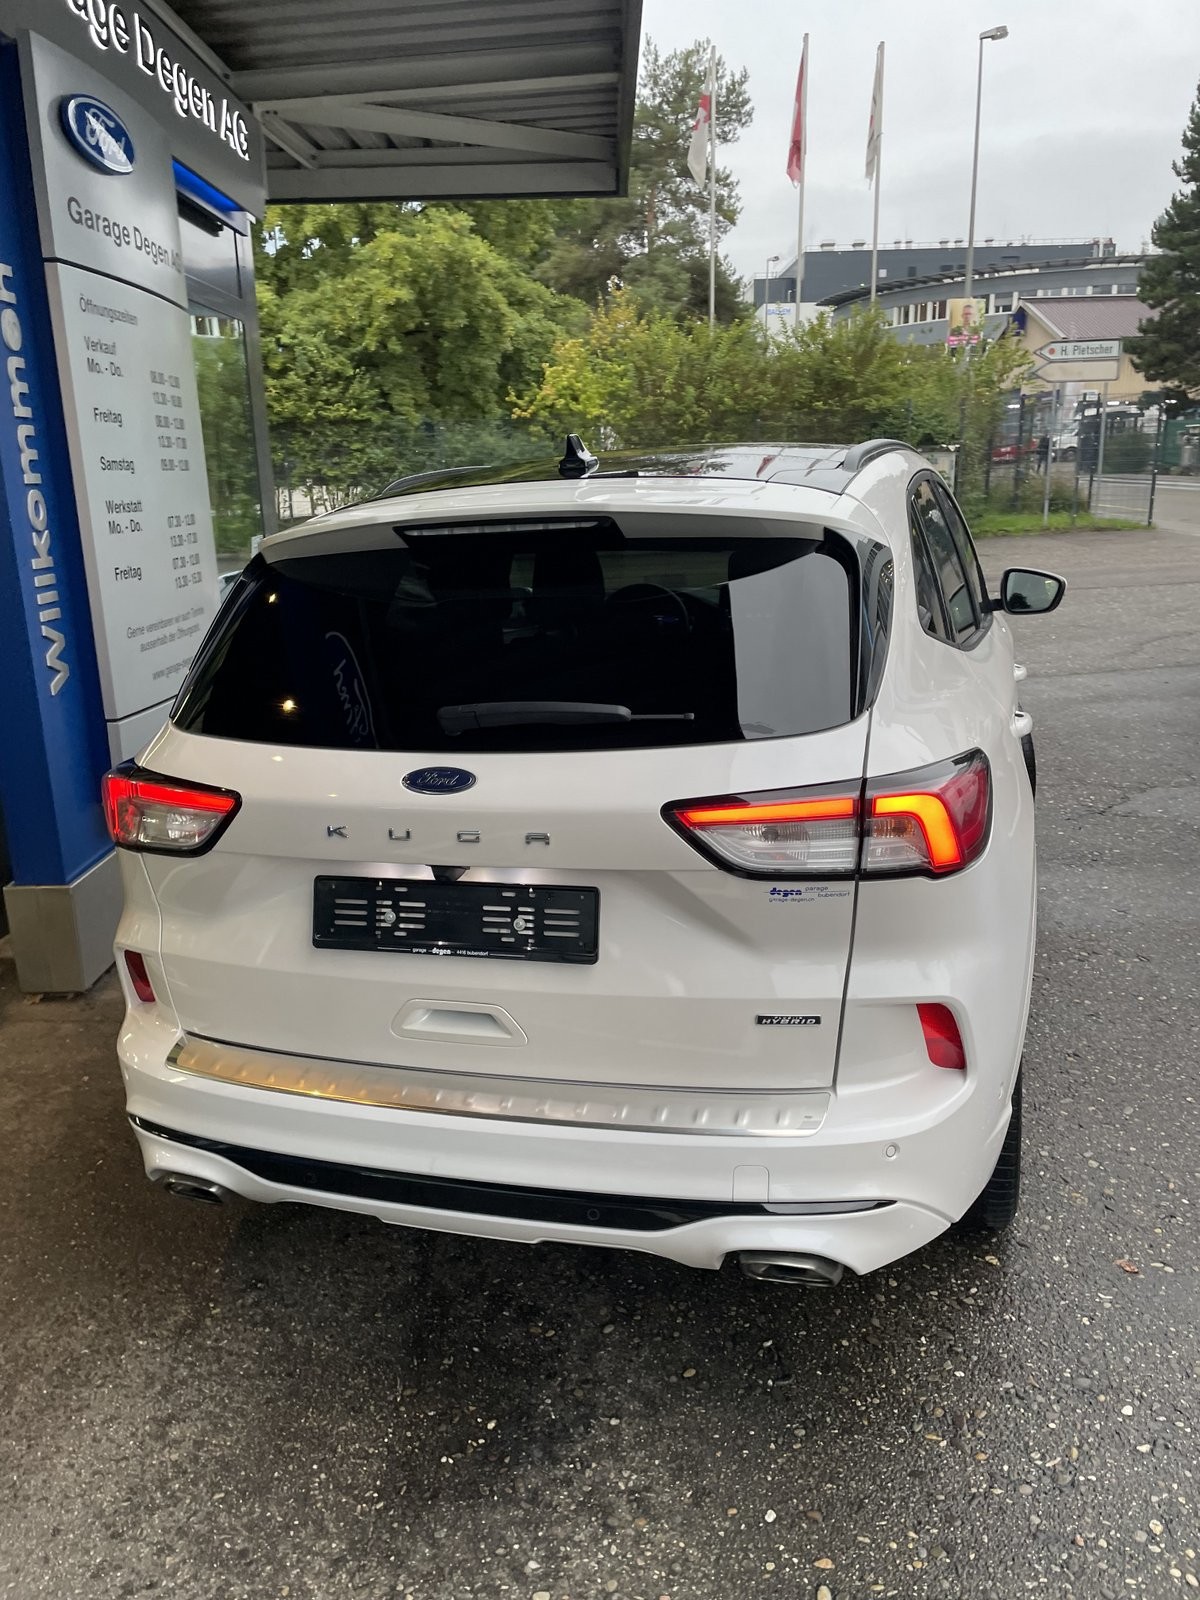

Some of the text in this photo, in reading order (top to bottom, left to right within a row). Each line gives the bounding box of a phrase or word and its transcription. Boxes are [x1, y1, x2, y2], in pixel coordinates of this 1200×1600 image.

[133, 12, 217, 133] Degen
[219, 98, 250, 162] AG
[67, 196, 131, 248] Garage
[132, 225, 171, 267] Degen
[86, 357, 103, 375] Mo.
[109, 361, 124, 378] Do.
[93, 407, 123, 428] Freitag
[100, 455, 135, 475] Samstag
[105, 499, 143, 514] Werkstatt
[108, 520, 124, 535] Mo.
[129, 519, 143, 533] Do.
[114, 566, 142, 581] Freitag
[327, 825, 550, 846] KUGA
[770, 887, 802, 898] degen
[432, 947, 452, 956] degen
